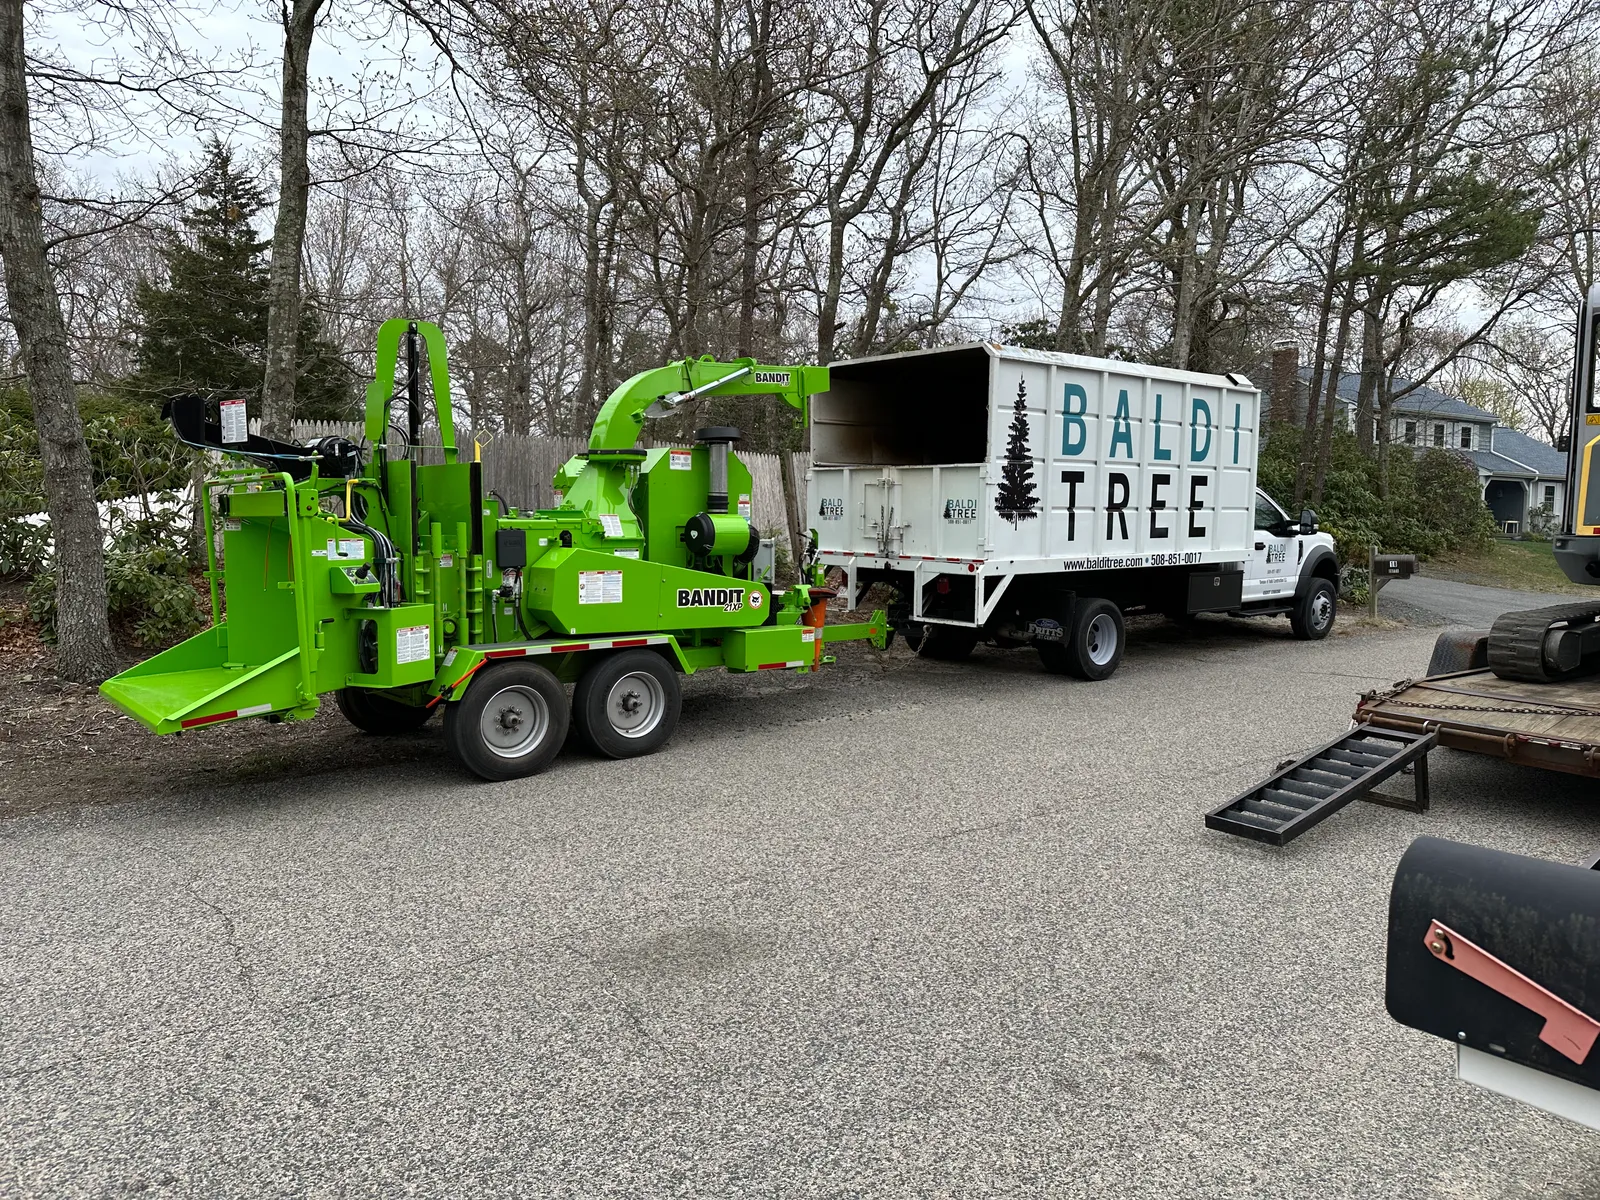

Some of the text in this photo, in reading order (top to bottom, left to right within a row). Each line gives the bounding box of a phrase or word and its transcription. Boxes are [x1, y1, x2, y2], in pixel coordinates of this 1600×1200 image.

[755, 372, 791, 383] BANDIT
[1062, 382, 1241, 464] BALDI
[822, 498, 843, 506] BALD
[949, 499, 977, 509] BALDI
[1061, 471, 1208, 541] TREE
[825, 507, 844, 516] TREE
[951, 509, 977, 519] TREE
[1269, 544, 1286, 553] BALDI
[1063, 552, 1202, 571] www.balditree.com 508-851-0017
[1271, 553, 1286, 562] TREE
[678, 589, 744, 606] BANDIT
[724, 603, 743, 611] 21XP
[1028, 623, 1064, 638] FRITTS
